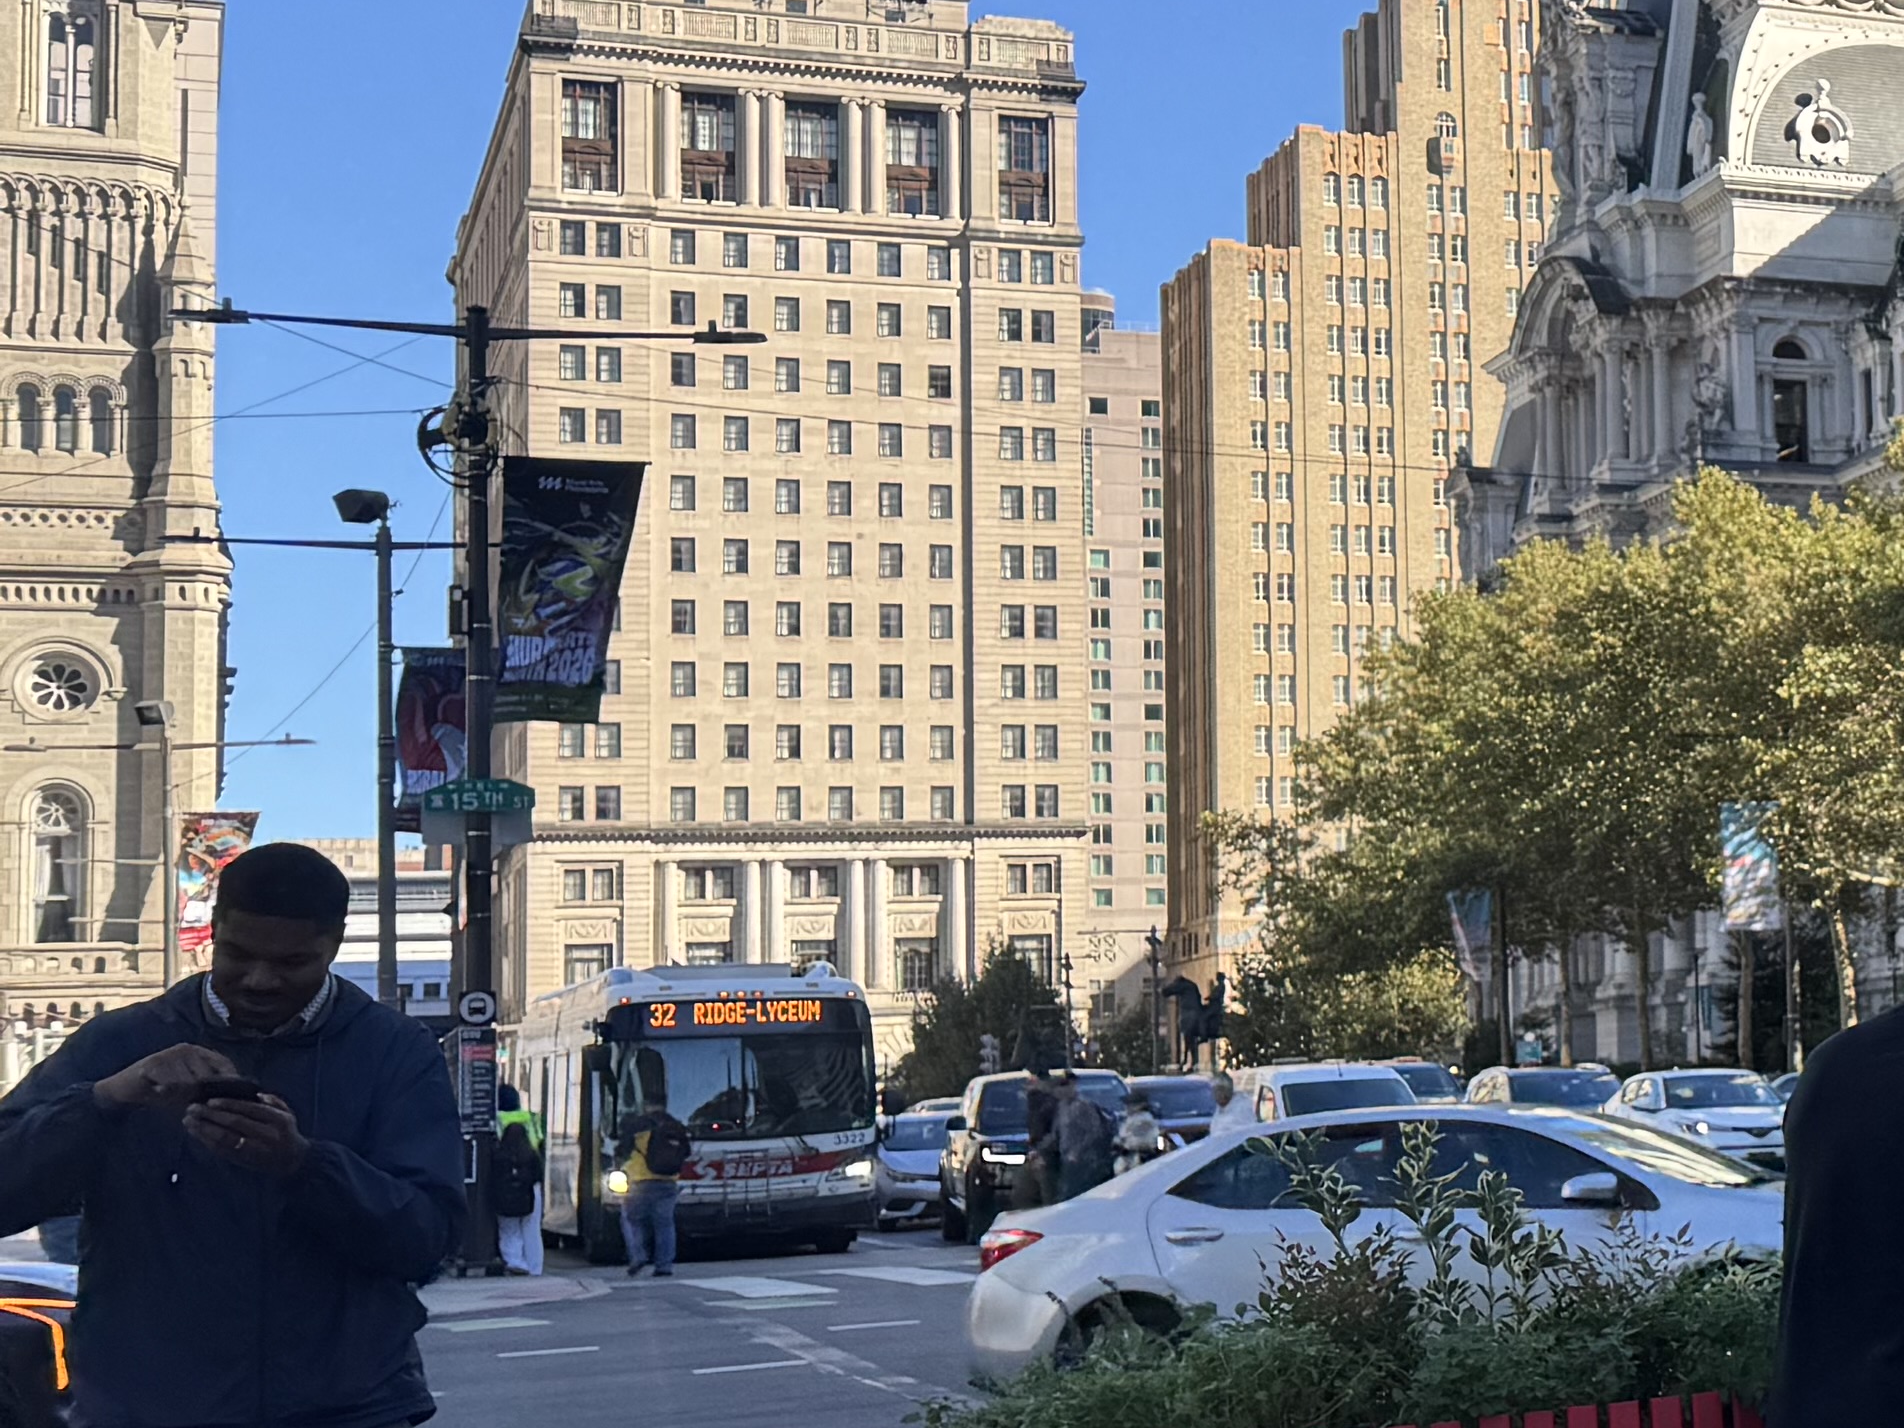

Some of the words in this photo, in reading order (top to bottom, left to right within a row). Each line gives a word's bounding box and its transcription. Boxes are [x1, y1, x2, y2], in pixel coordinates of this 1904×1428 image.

[451, 791, 503, 811] 15TH
[513, 795, 529, 809] ST
[650, 1003, 676, 1027] 32
[694, 1000, 821, 1025] RIDGE-LYCEUM
[724, 1160, 793, 1178] SEPTA
